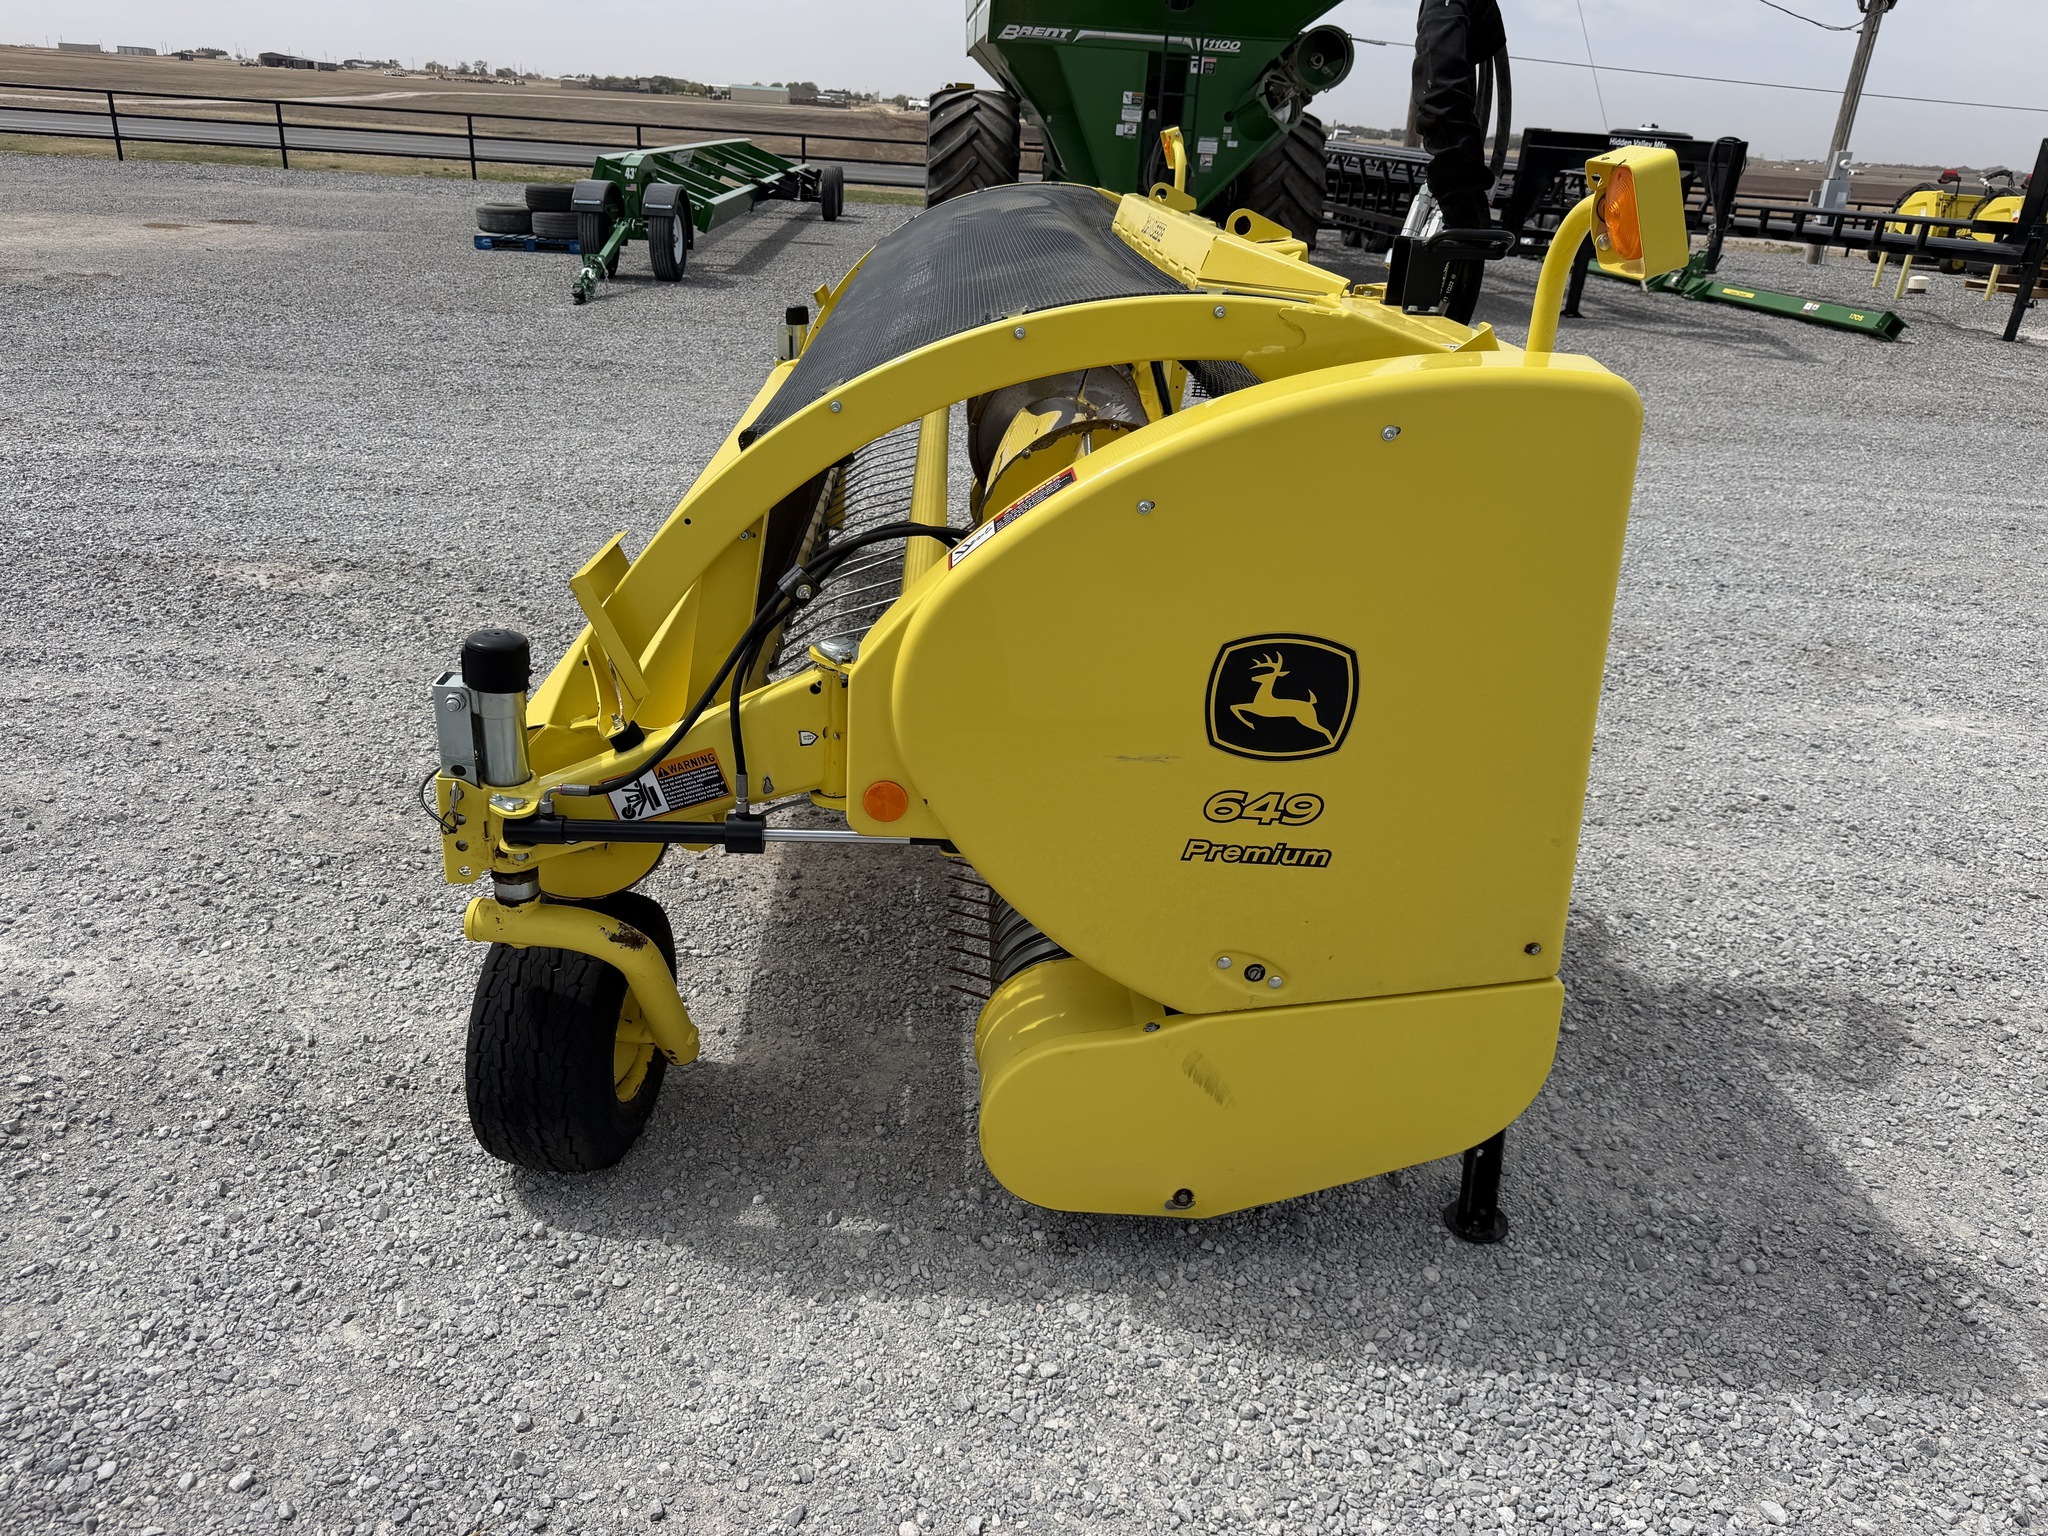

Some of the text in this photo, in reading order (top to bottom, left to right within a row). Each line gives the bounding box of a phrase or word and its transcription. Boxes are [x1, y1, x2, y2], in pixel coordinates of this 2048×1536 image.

[997, 24, 1072, 40] BRENT
[1208, 39, 1241, 50] 1100
[1609, 137, 1632, 147] Hidden
[1633, 139, 1653, 148] Valley
[667, 753, 716, 774] WARNING
[1203, 790, 1324, 826] 649
[1181, 838, 1332, 868] Premium
